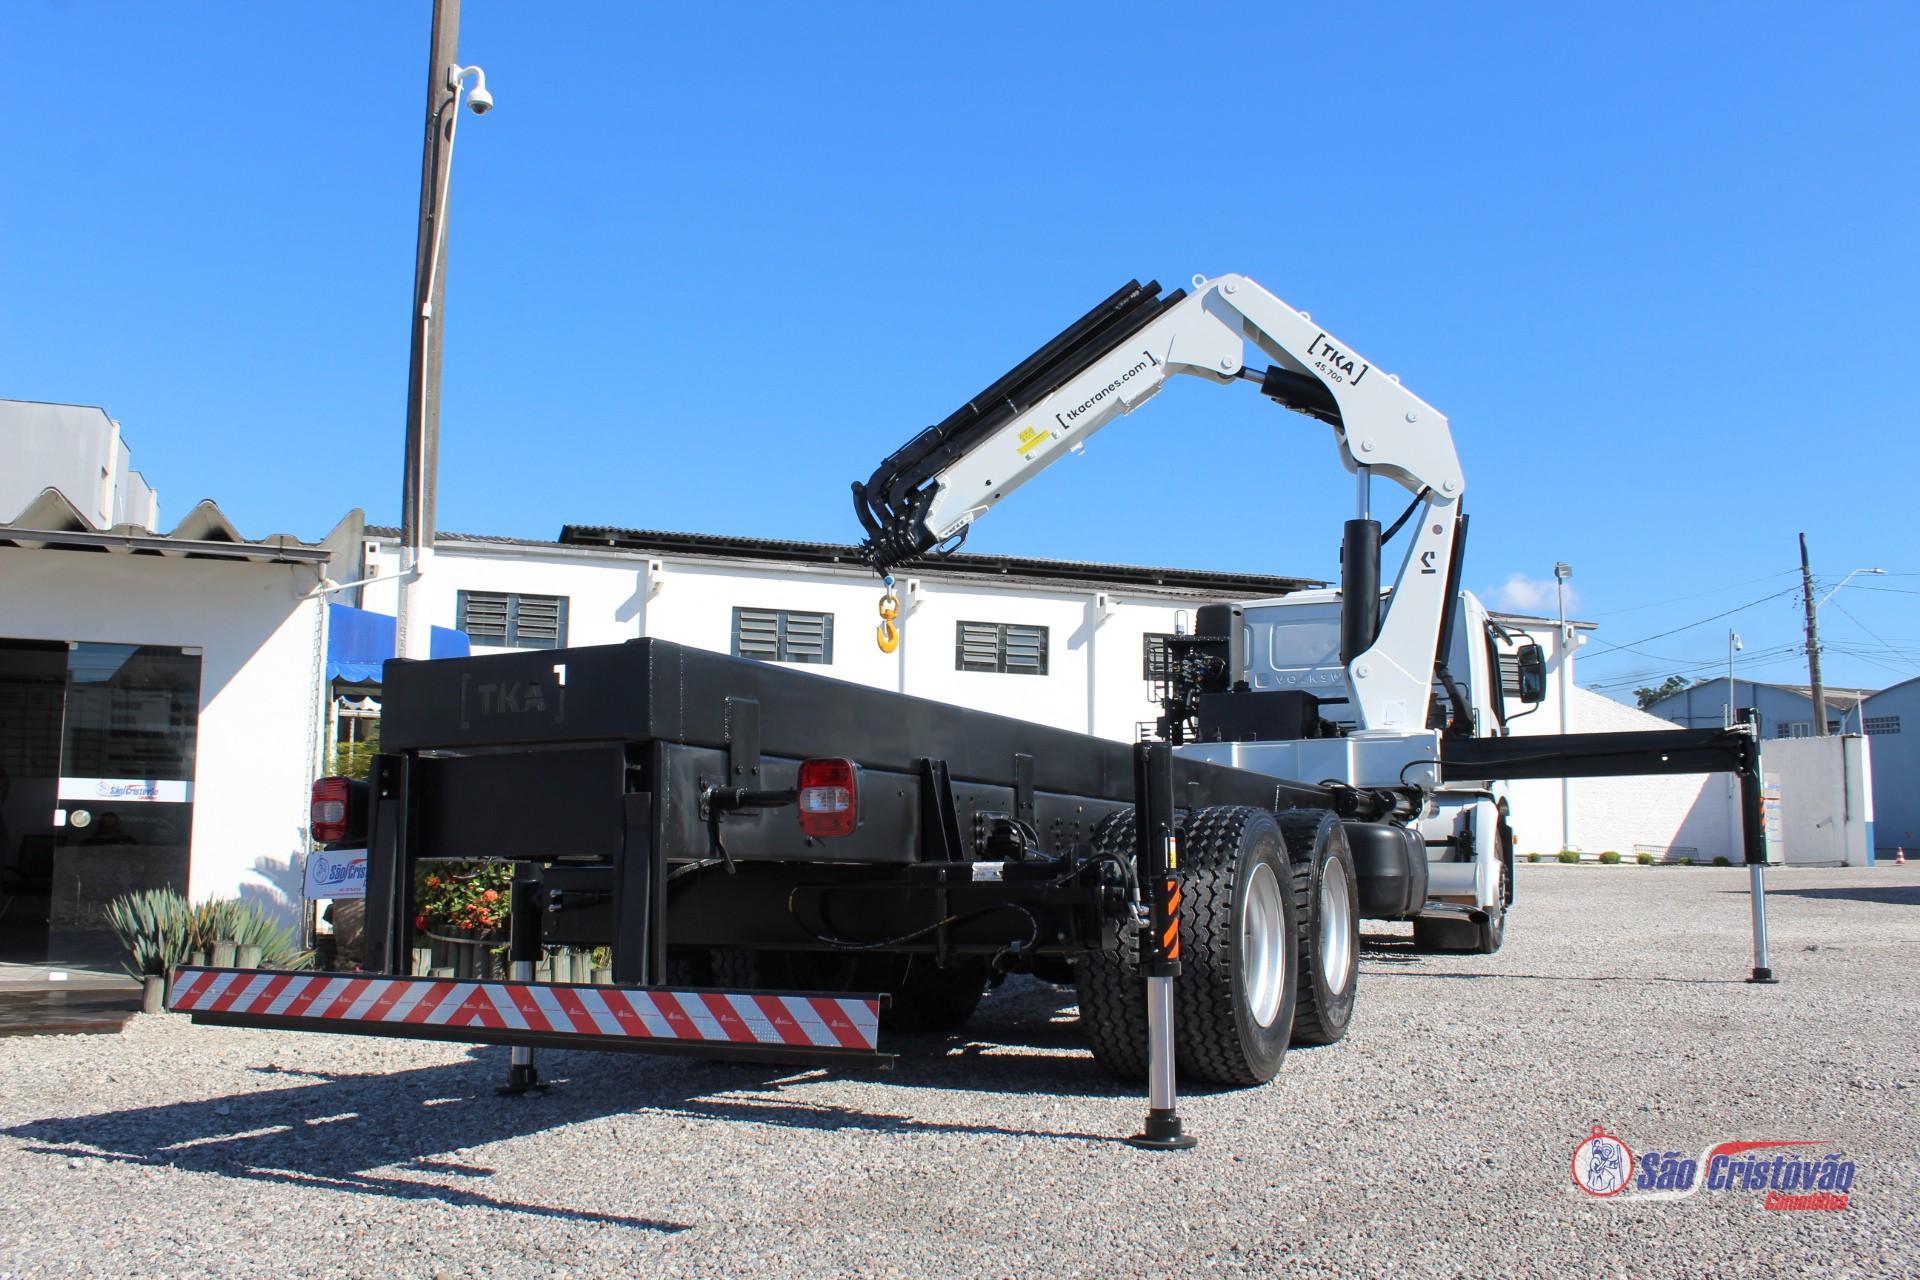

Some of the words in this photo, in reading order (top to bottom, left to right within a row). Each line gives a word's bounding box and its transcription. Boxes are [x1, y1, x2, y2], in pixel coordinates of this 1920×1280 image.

[1314, 361, 1343, 383] 45.700
[1066, 360, 1147, 421] tkacranes.com
[329, 863, 346, 881] São
[347, 864, 368, 880] Cris
